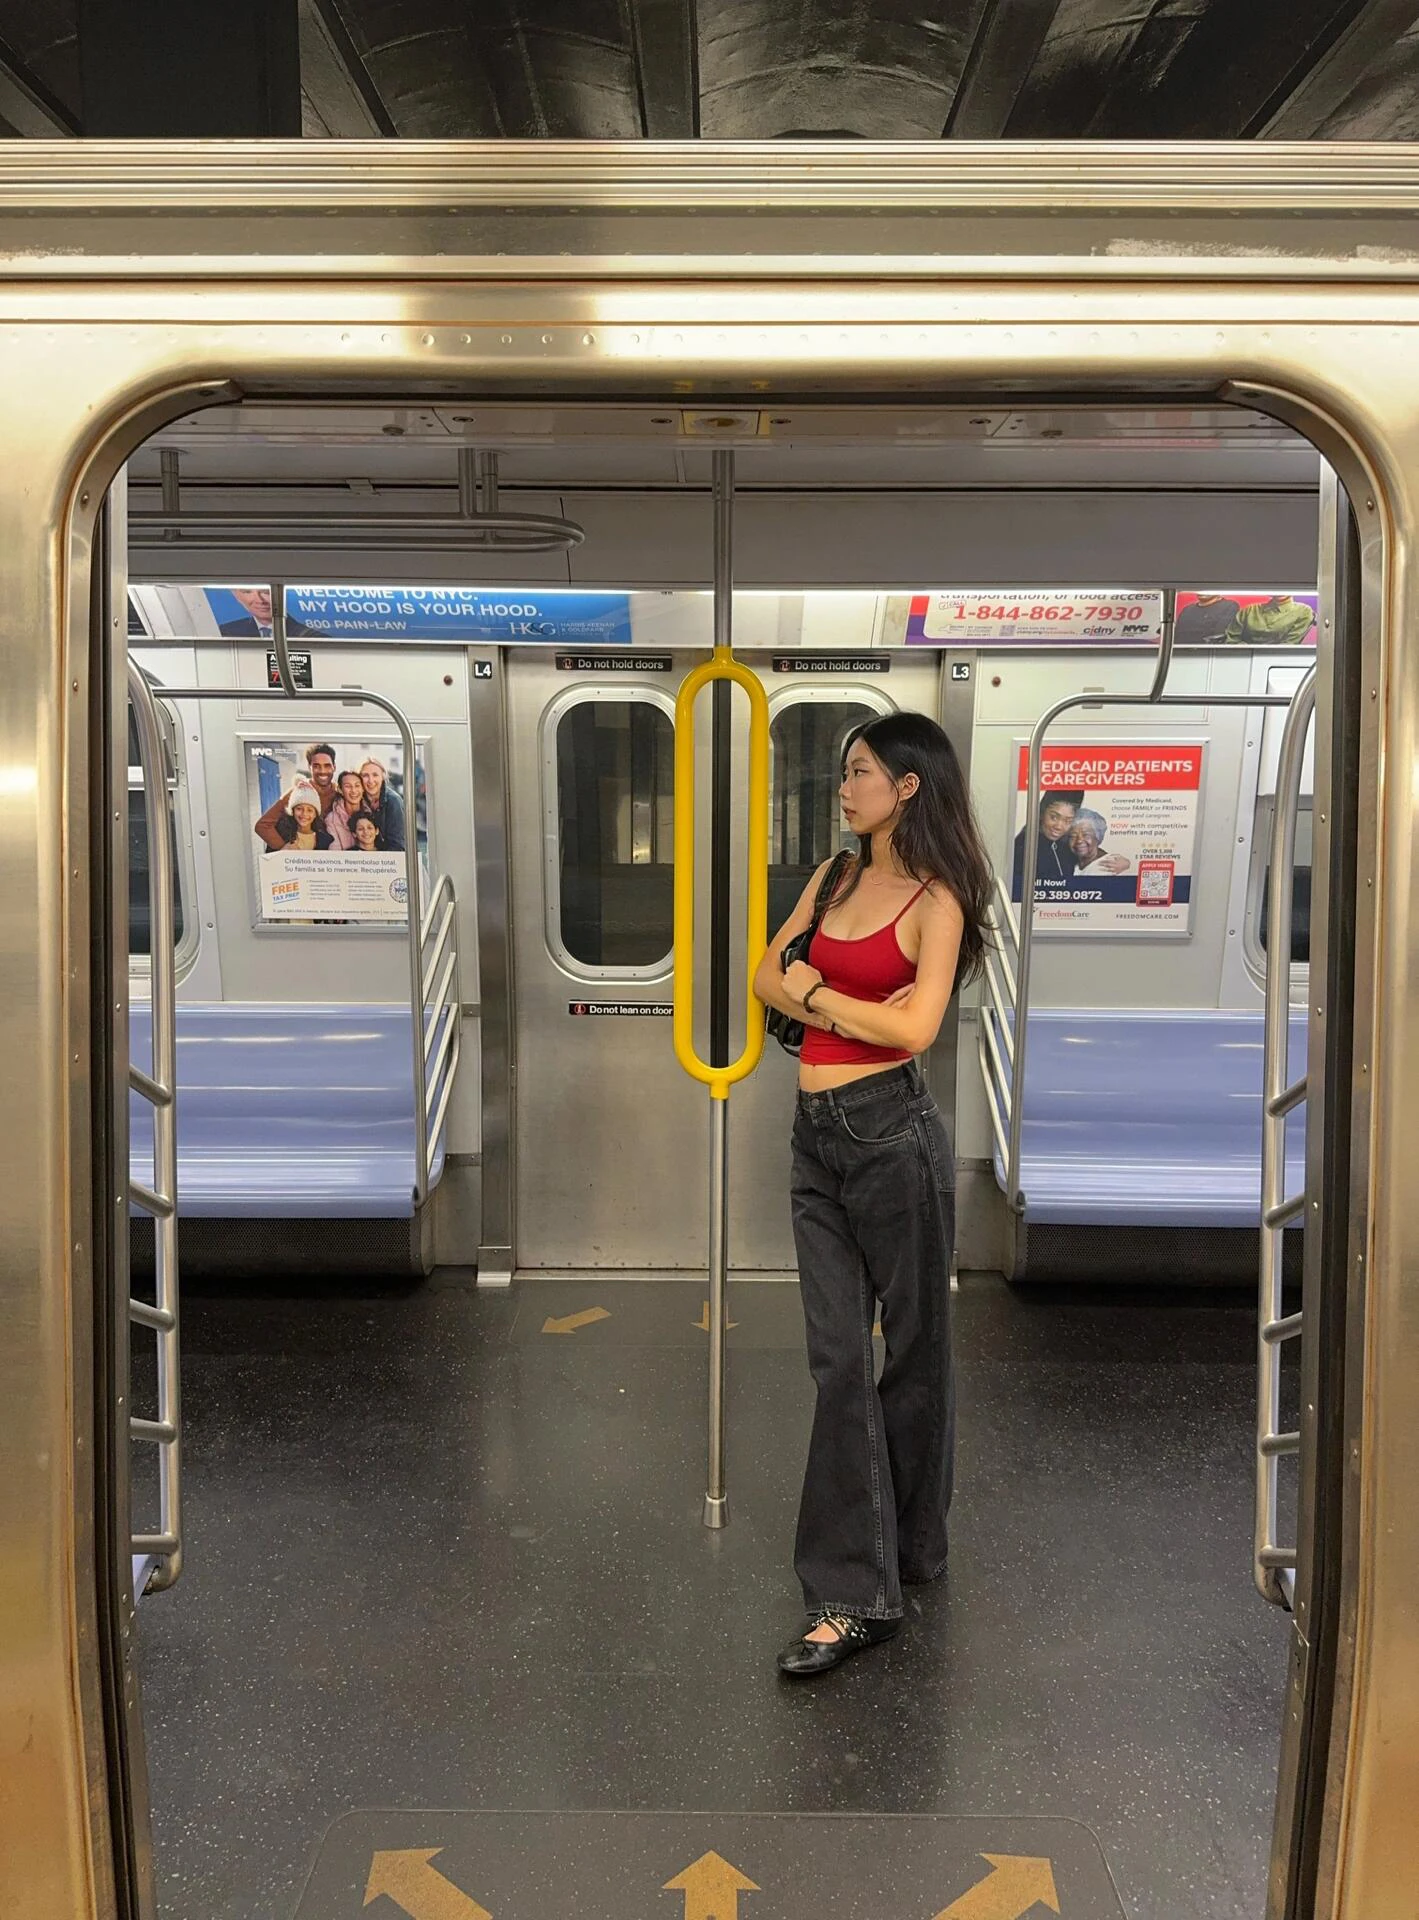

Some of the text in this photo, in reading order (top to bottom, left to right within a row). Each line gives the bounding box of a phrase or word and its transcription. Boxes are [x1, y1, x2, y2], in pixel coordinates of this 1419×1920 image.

[295, 588, 479, 601] WELCOME TO NYC.
[299, 600, 543, 617] MY HOOD IS YOUR HOOD.
[953, 604, 1143, 621] 1-844-862-7930
[305, 619, 407, 631] 800 PAIN-LAW
[474, 663, 492, 677] L4
[578, 658, 664, 670] Do not hold doors
[795, 661, 881, 671] Do not hold doors
[952, 666, 970, 679] L3
[1041, 760, 1193, 773] EDICAID PATIENTS
[1041, 773, 1145, 785] CAREGIVERS
[272, 881, 300, 895] FREE
[1043, 879, 1067, 887] Now!
[272, 894, 284, 902] TAX
[1034, 890, 1103, 900] 29.389.0872
[1039, 909, 1090, 918] FreedomCare
[589, 1005, 673, 1015] Do not lean on door
